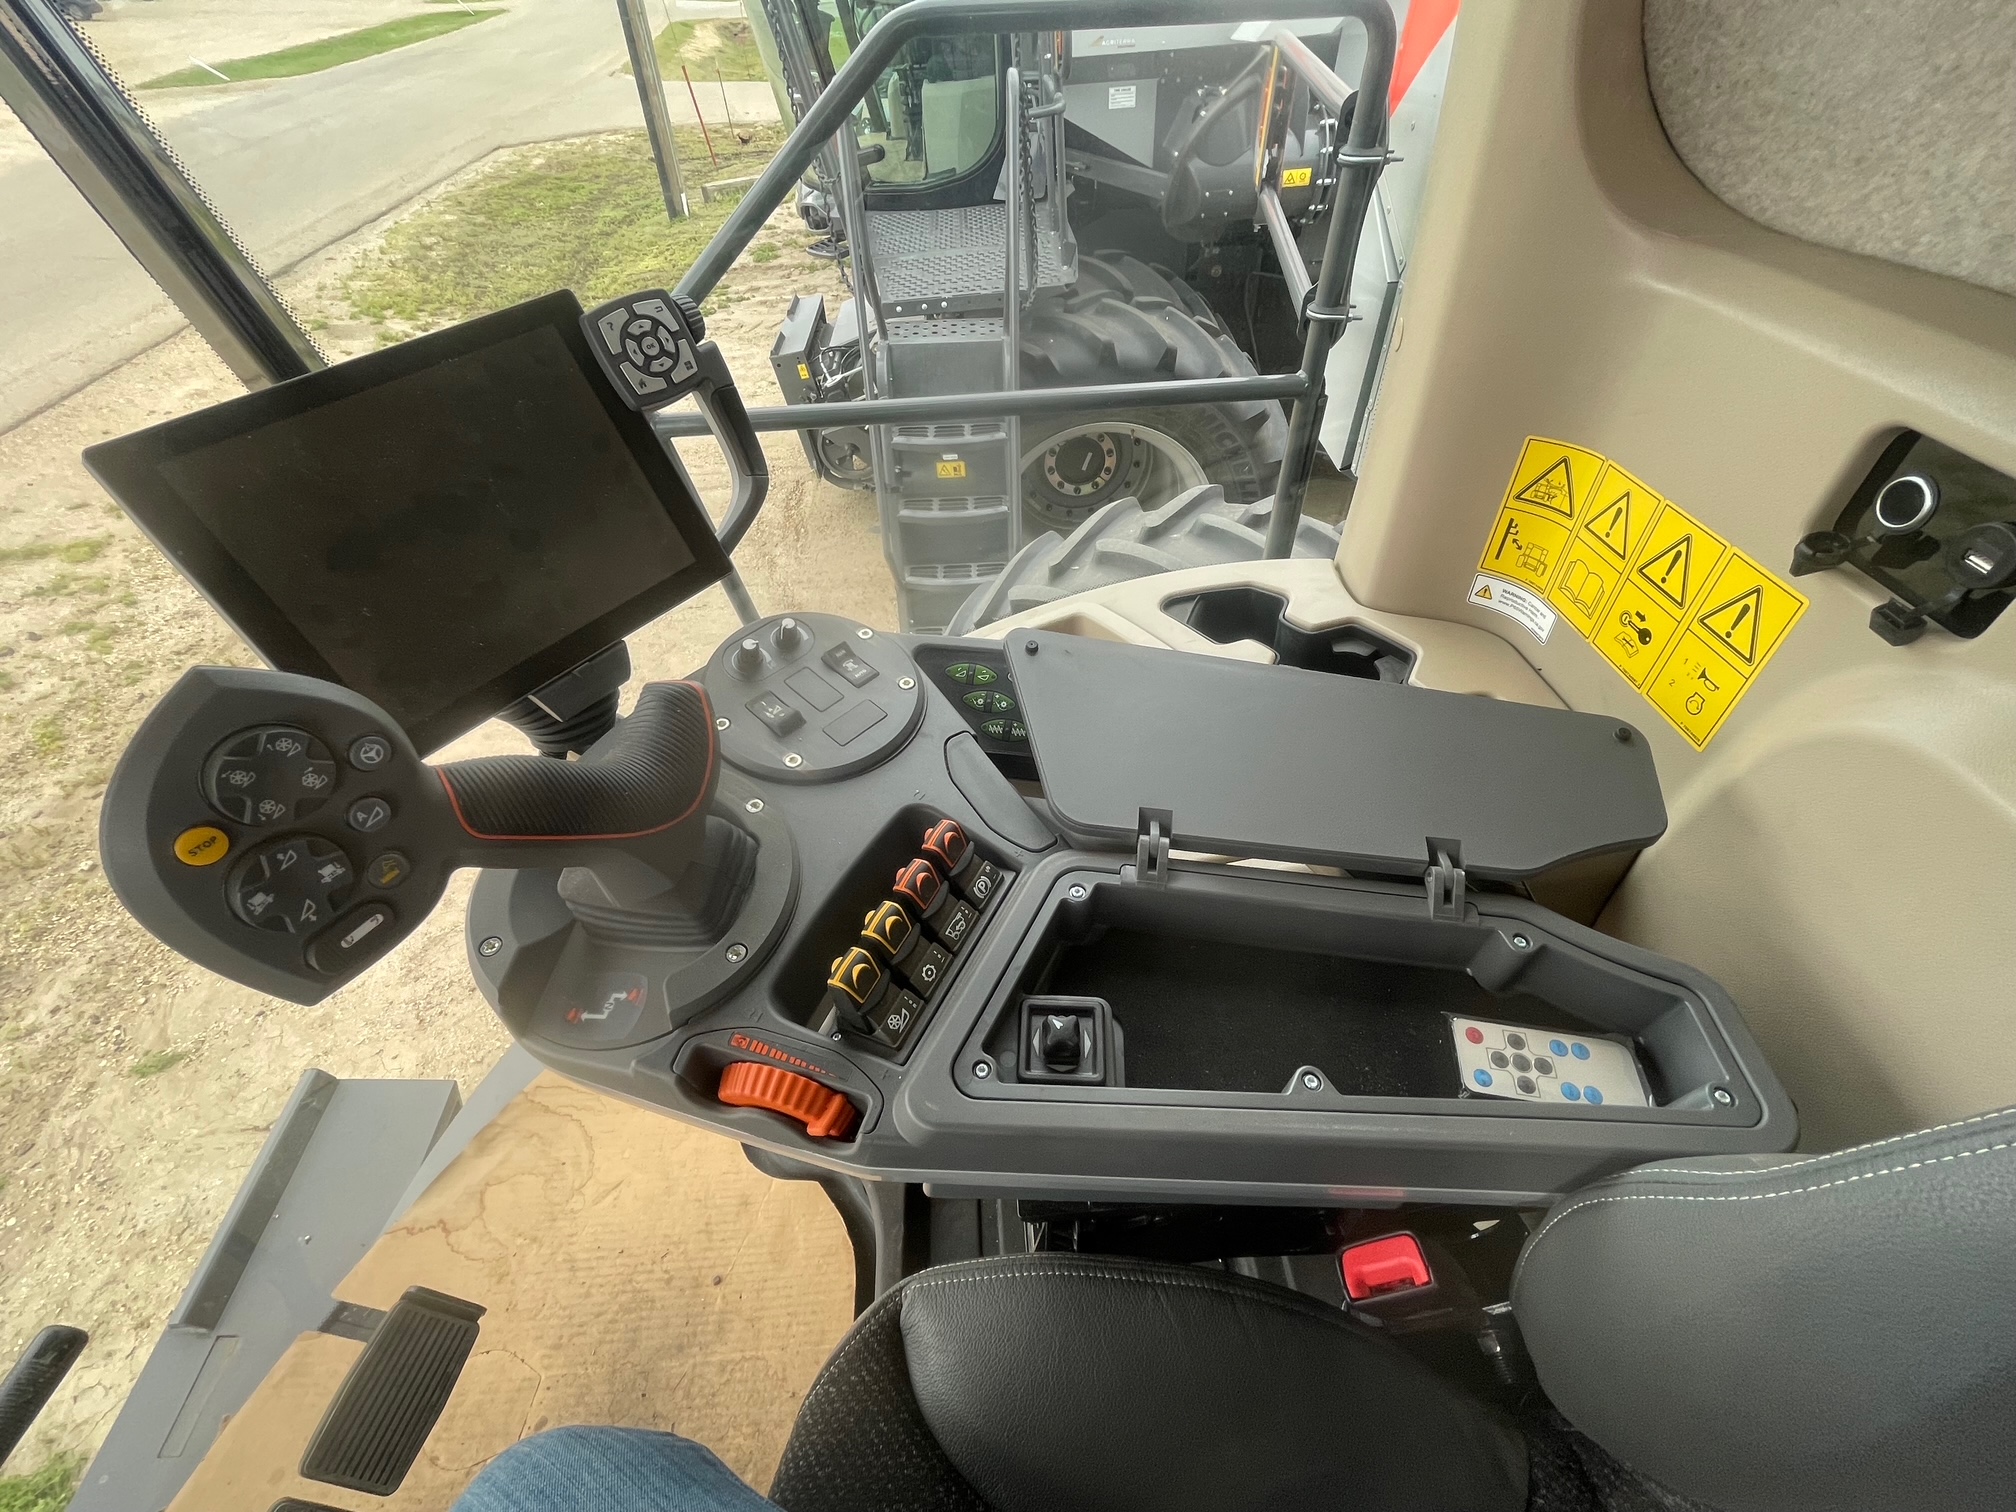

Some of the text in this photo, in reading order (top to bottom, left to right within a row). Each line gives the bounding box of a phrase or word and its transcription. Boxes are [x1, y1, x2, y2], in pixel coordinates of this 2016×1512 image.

[646, 342, 656, 350] OK
[1668, 678, 1676, 687] 2
[188, 835, 218, 857] STOP
